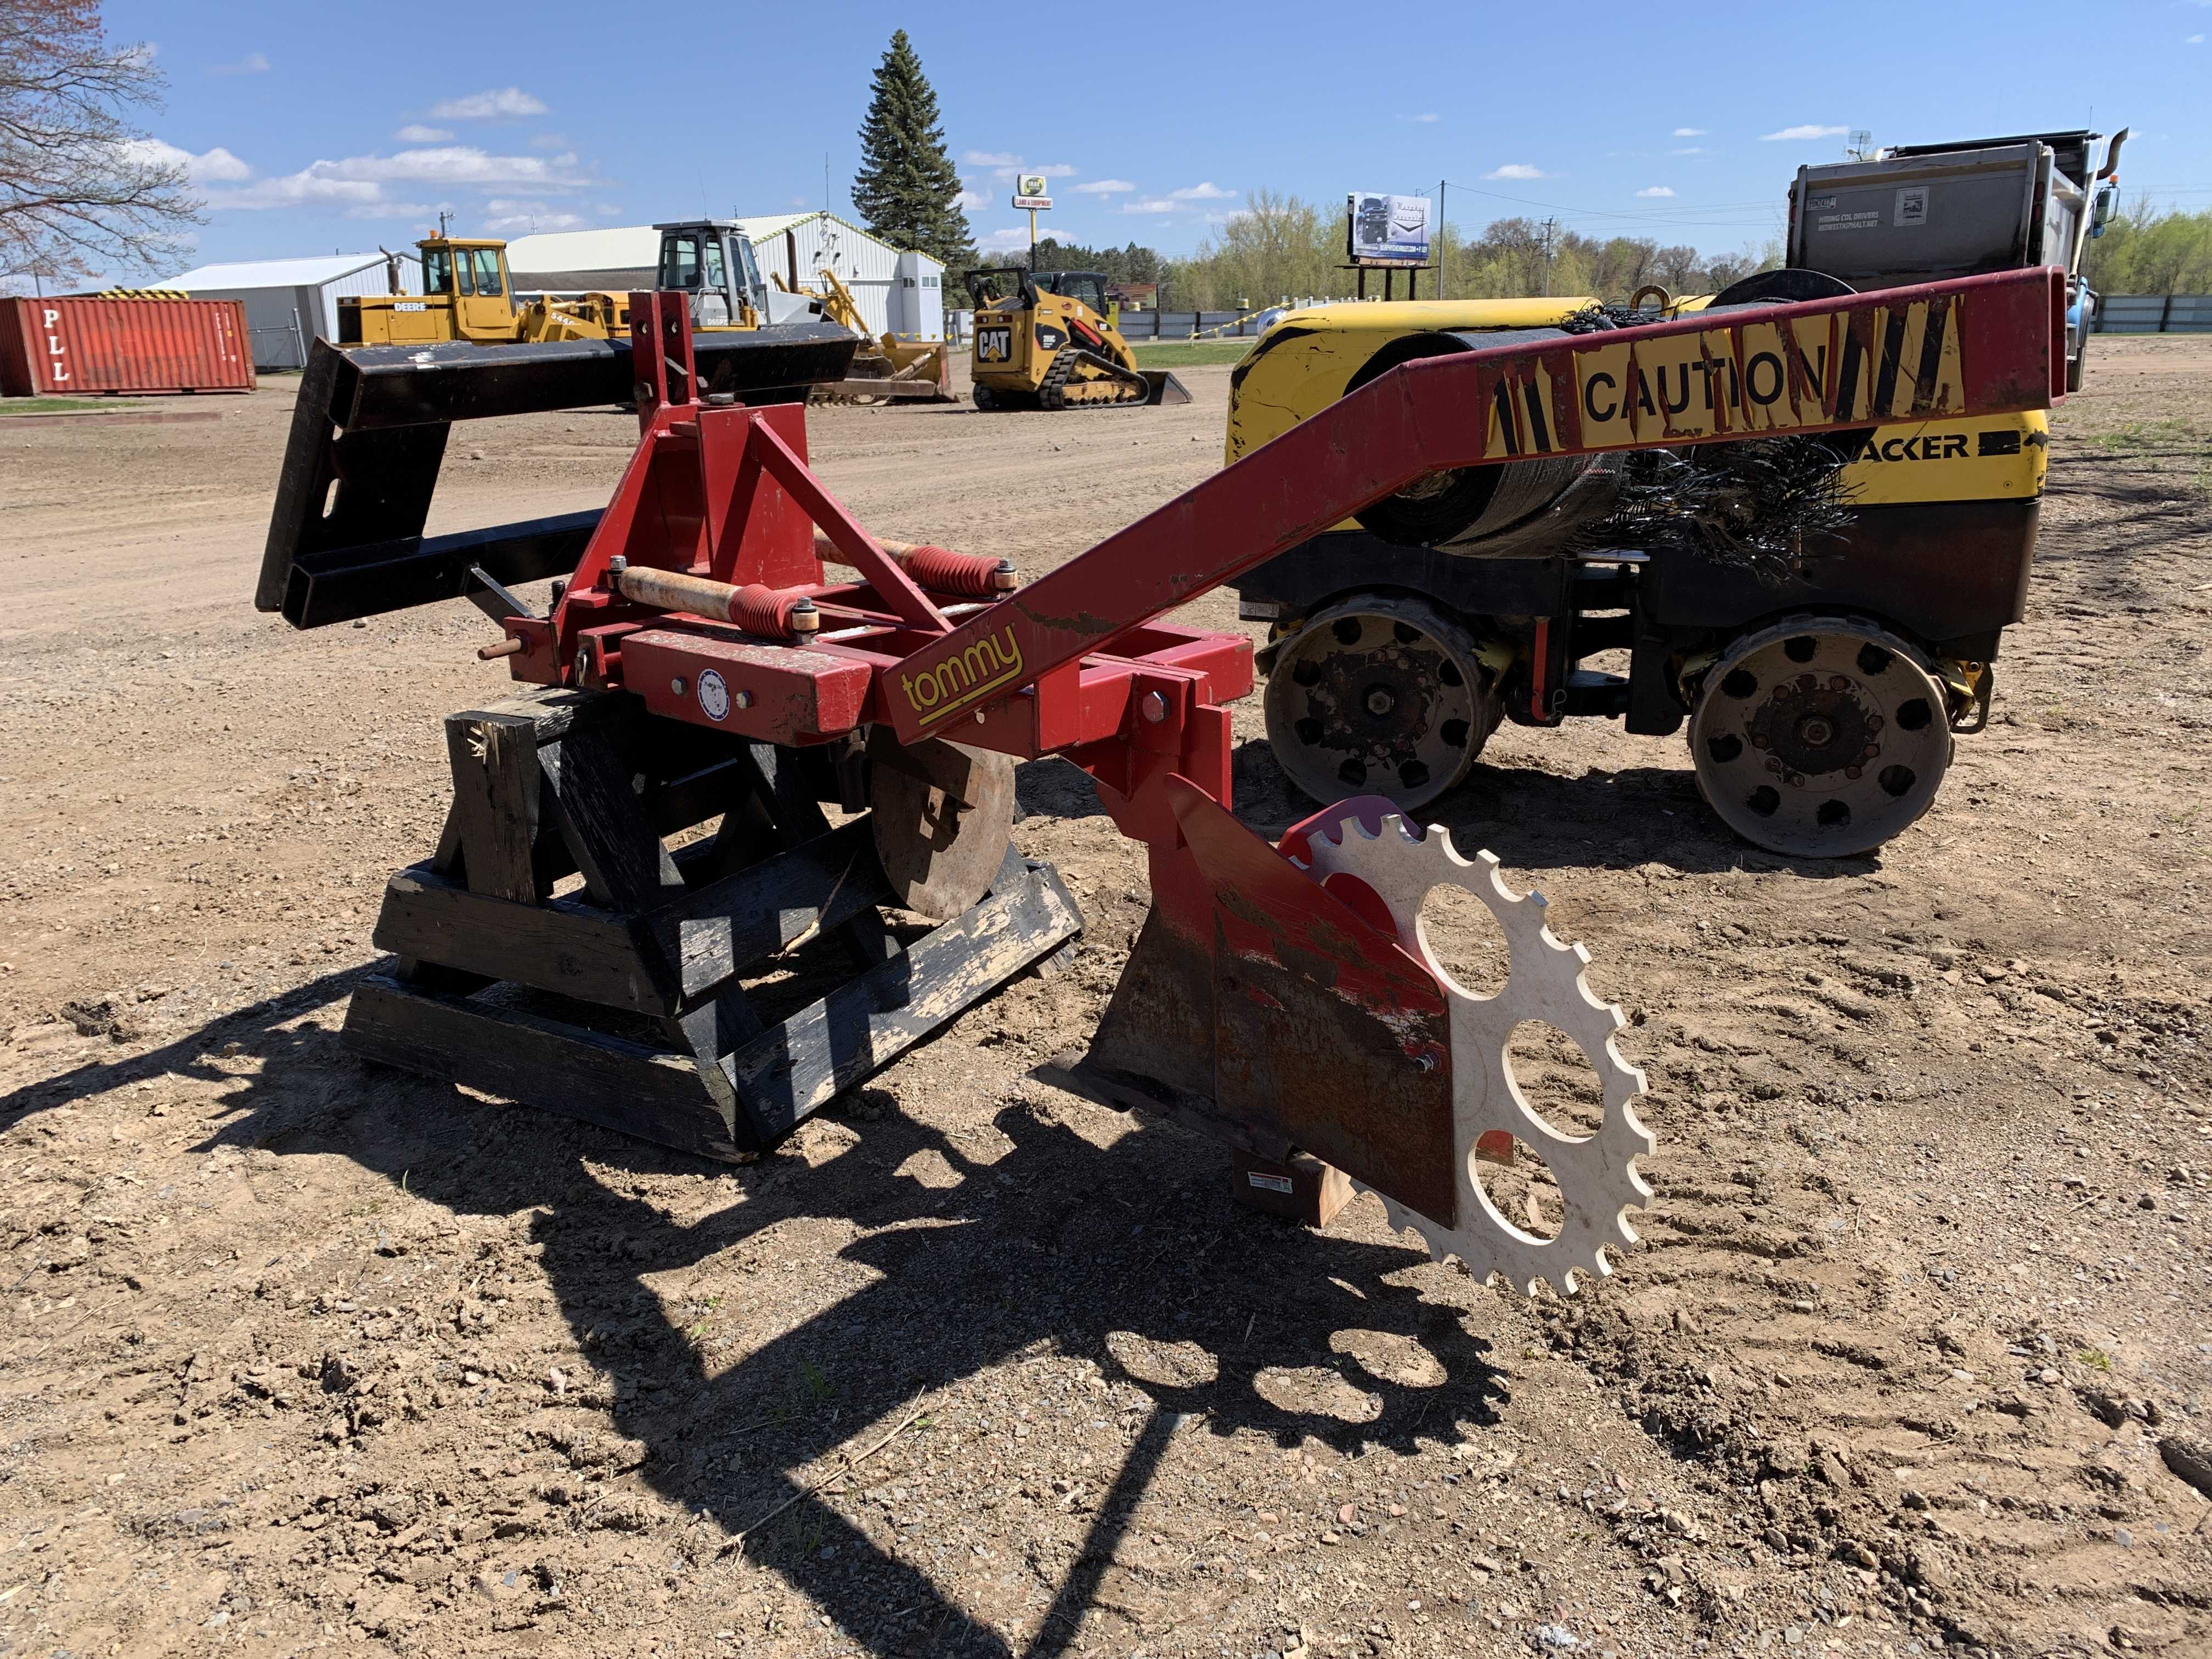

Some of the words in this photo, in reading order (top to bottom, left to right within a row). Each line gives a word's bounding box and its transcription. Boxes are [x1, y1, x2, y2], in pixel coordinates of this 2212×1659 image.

[1853, 211, 1879, 219] DRIVERS
[394, 302, 426, 312] DEERE
[979, 331, 1009, 358] CAT
[1585, 345, 1827, 422] CAUTION
[1852, 434, 1970, 464] ACKER
[901, 625, 1023, 725] tommy
